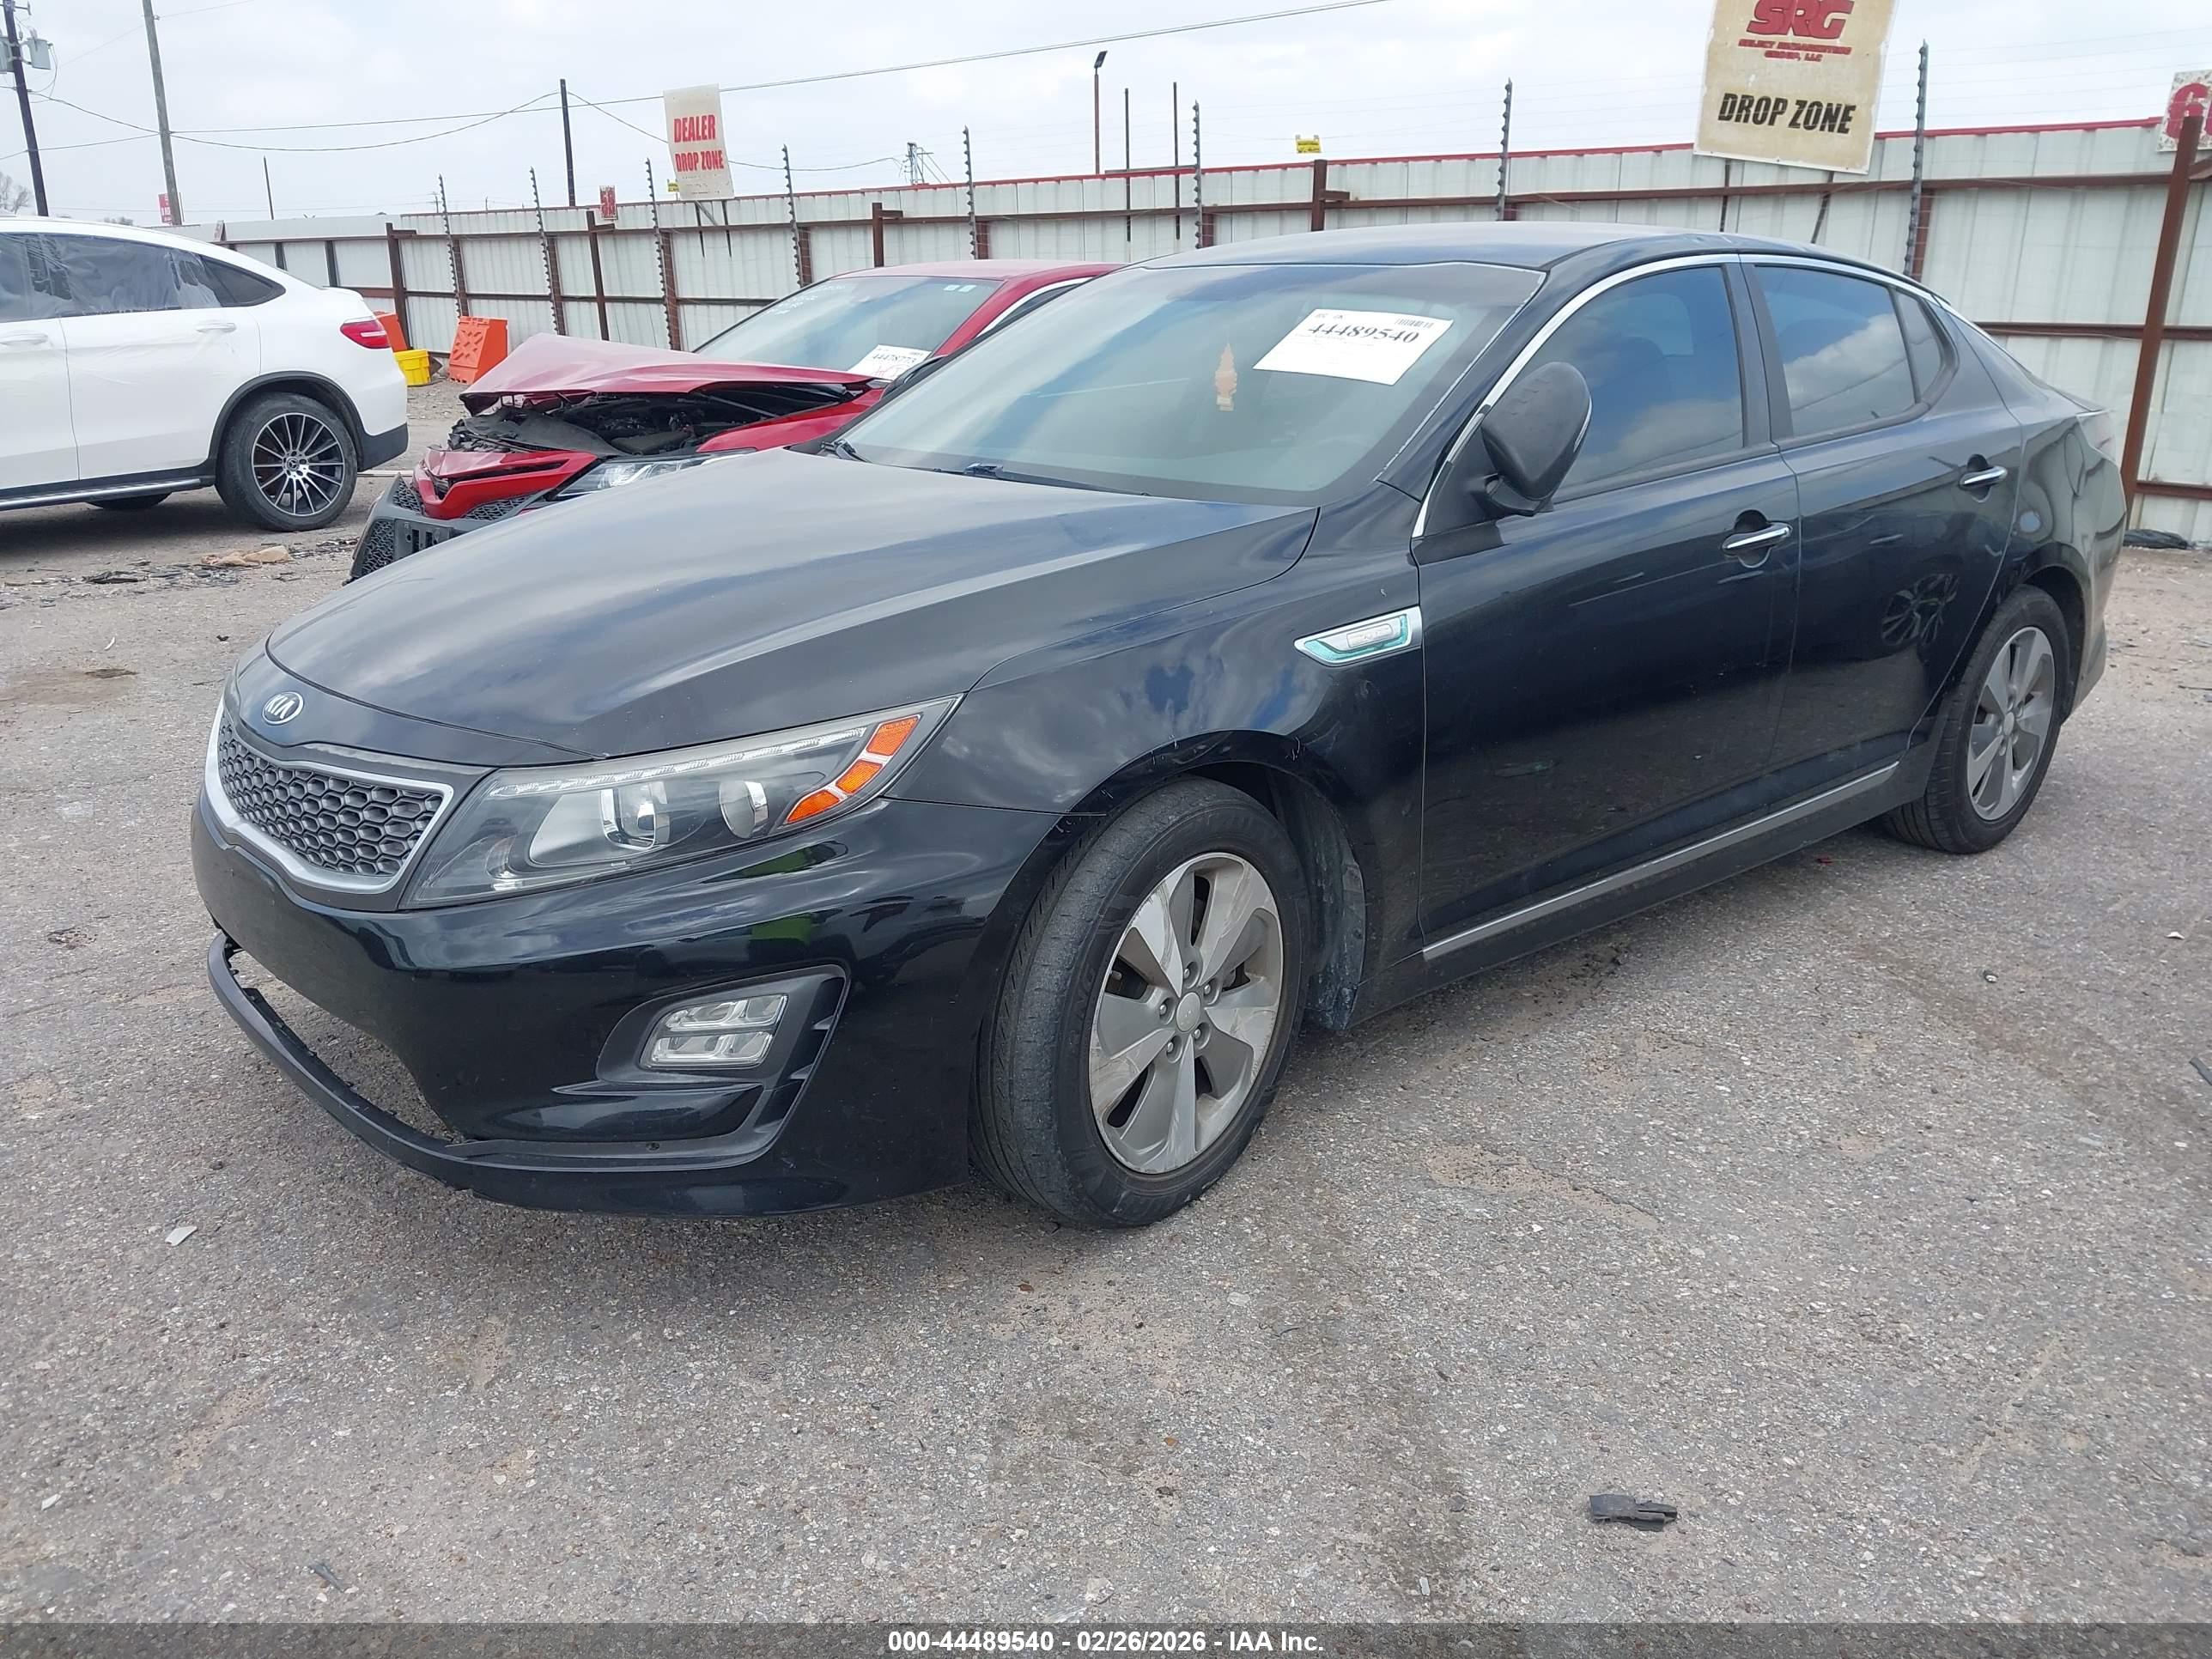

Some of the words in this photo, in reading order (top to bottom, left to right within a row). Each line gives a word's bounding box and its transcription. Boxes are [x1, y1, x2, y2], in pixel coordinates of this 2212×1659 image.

[1746, 0, 1855, 40] SRG
[1804, 52, 1823, 62] LLC
[1718, 92, 1788, 126] DROP
[1788, 99, 1856, 135] ZONE
[673, 114, 716, 143] DEALER
[675, 152, 699, 172] DROP
[700, 149, 724, 171] ZONE
[1307, 322, 1420, 343] 44489540
